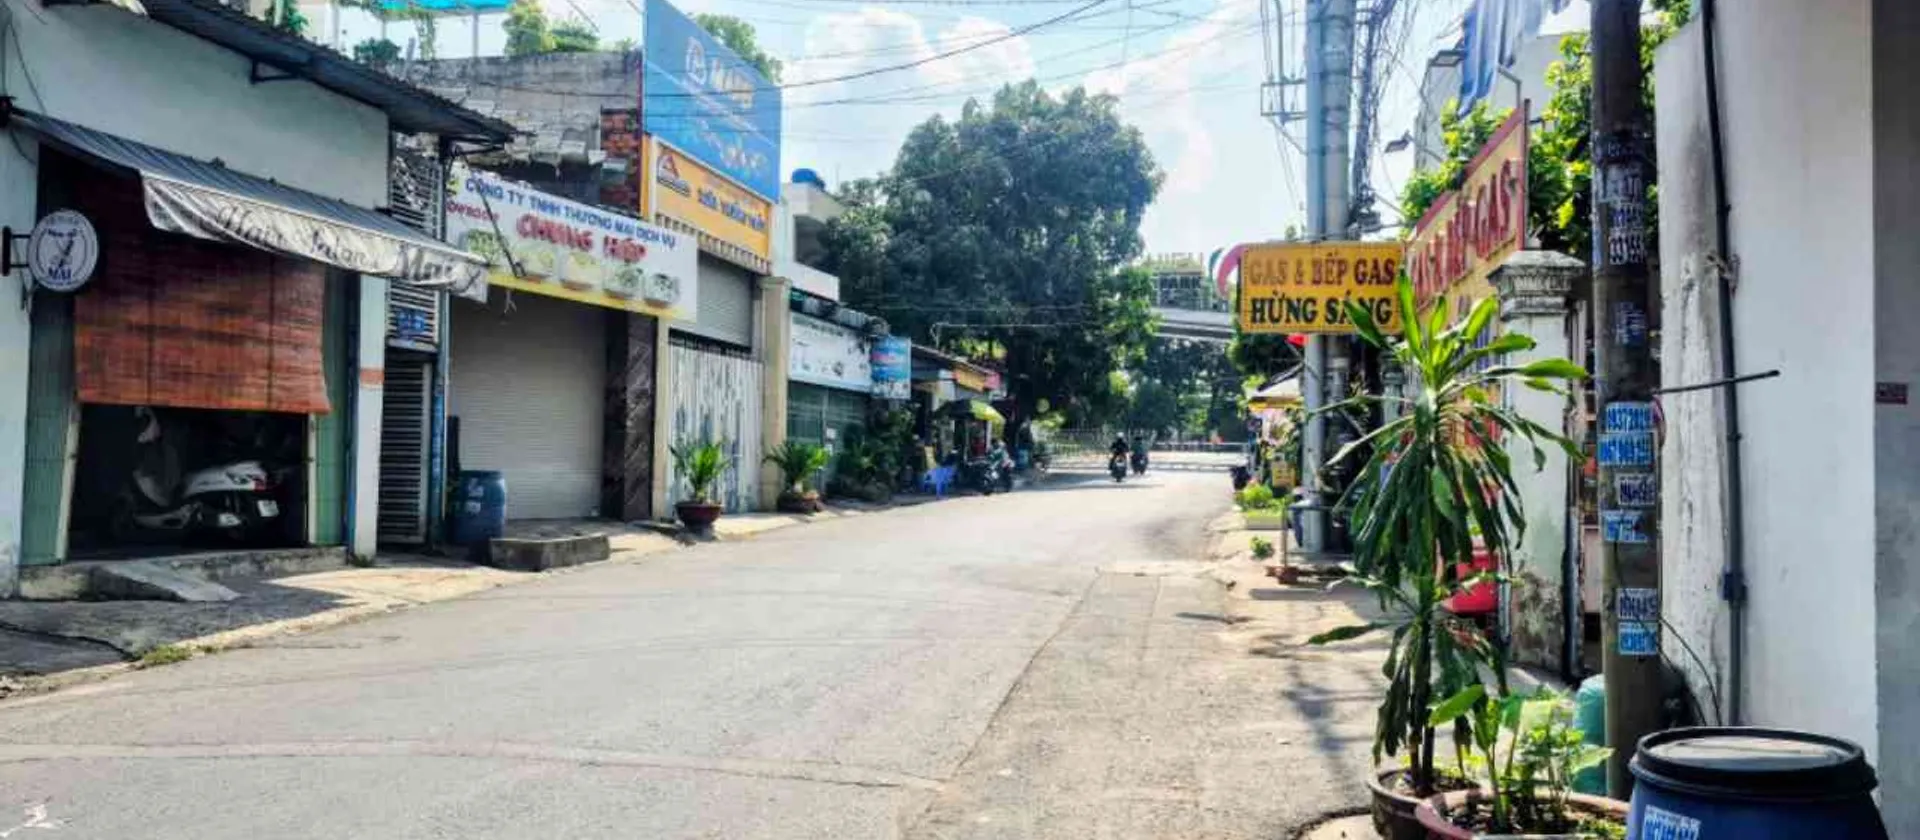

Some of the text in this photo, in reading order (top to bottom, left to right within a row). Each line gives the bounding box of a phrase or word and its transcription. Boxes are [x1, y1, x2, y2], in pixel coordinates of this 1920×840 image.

[507, 189, 526, 205] TY
[1251, 251, 1396, 285] GAS & BẾP GAS
